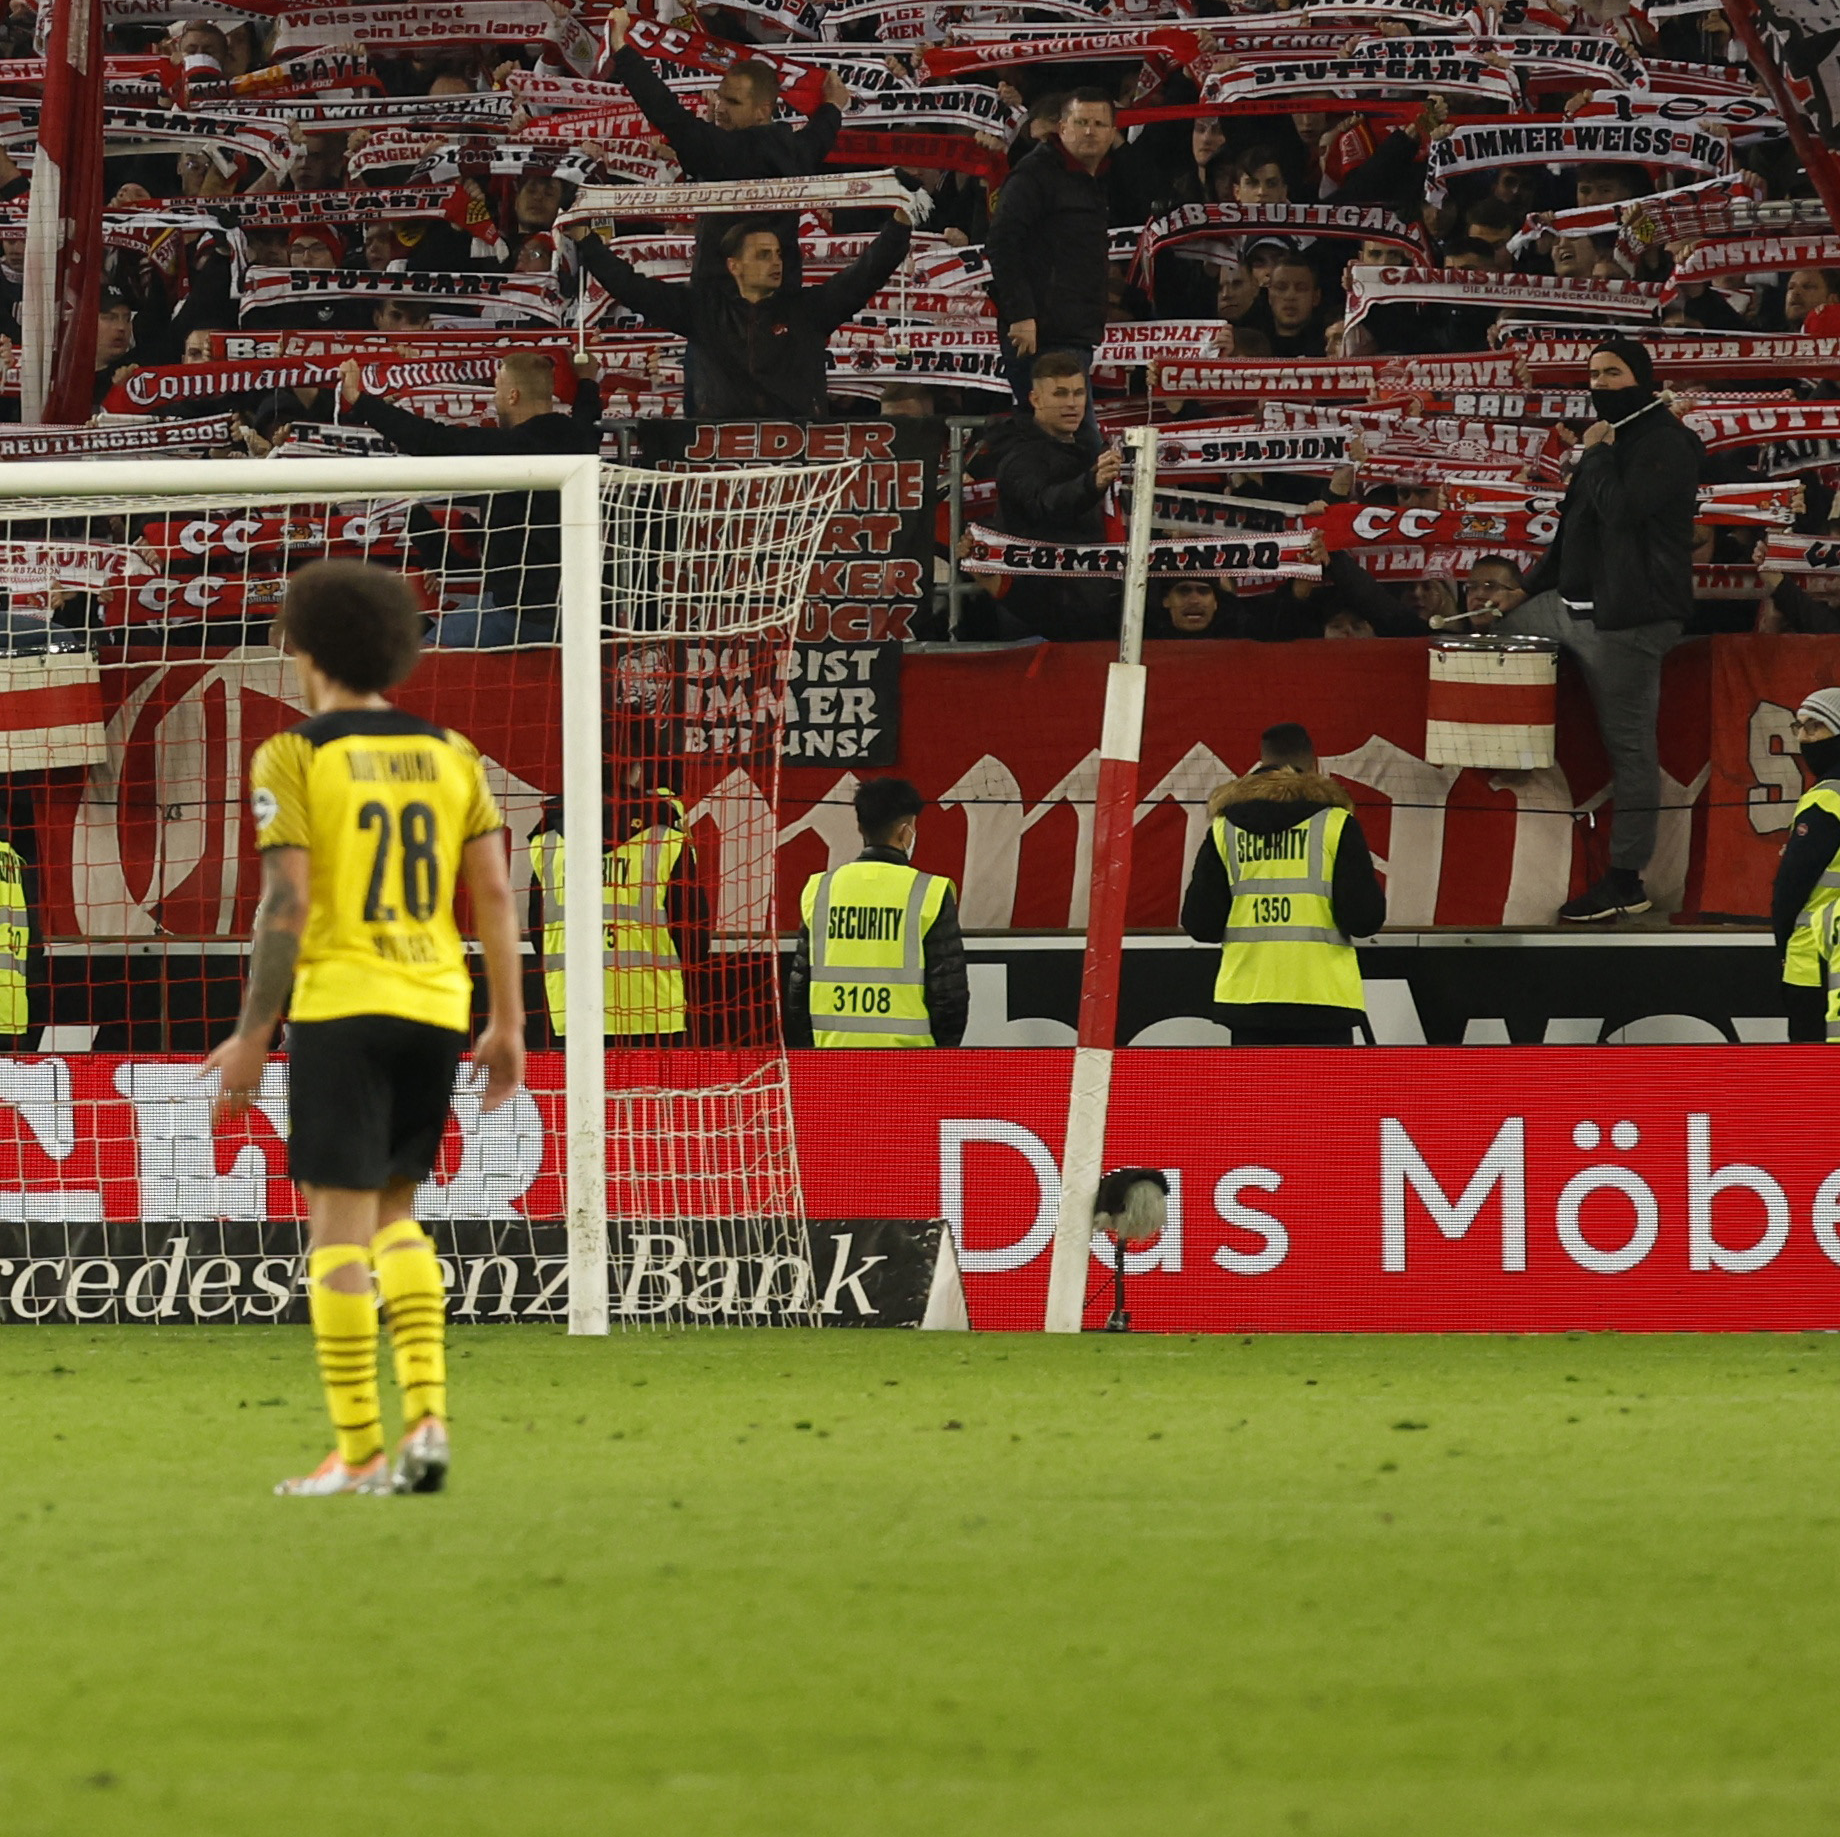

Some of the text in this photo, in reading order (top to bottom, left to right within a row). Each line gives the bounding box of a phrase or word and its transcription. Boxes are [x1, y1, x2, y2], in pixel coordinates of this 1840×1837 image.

[285, 3, 465, 29] Weiss und rot
[354, 19, 548, 43] ein Leben lang!
[1464, 123, 1672, 156] IMMER WEISS
[1149, 203, 1210, 239] VfB
[1101, 344, 1202, 361] FÜR IMMER
[1160, 366, 1374, 394] CANNSTATTER
[0, 422, 231, 458] REUTLINGEN 2005
[684, 422, 896, 459] JEDER
[1200, 437, 1348, 463] STADION
[777, 728, 882, 758] UNS!
[1236, 828, 1308, 863] SECURITY
[356, 799, 441, 924] 28
[828, 905, 904, 942] SECURITY
[1252, 896, 1291, 924] 1350
[832, 985, 892, 1015] 3108
[1379, 1110, 1840, 1278] Möb
